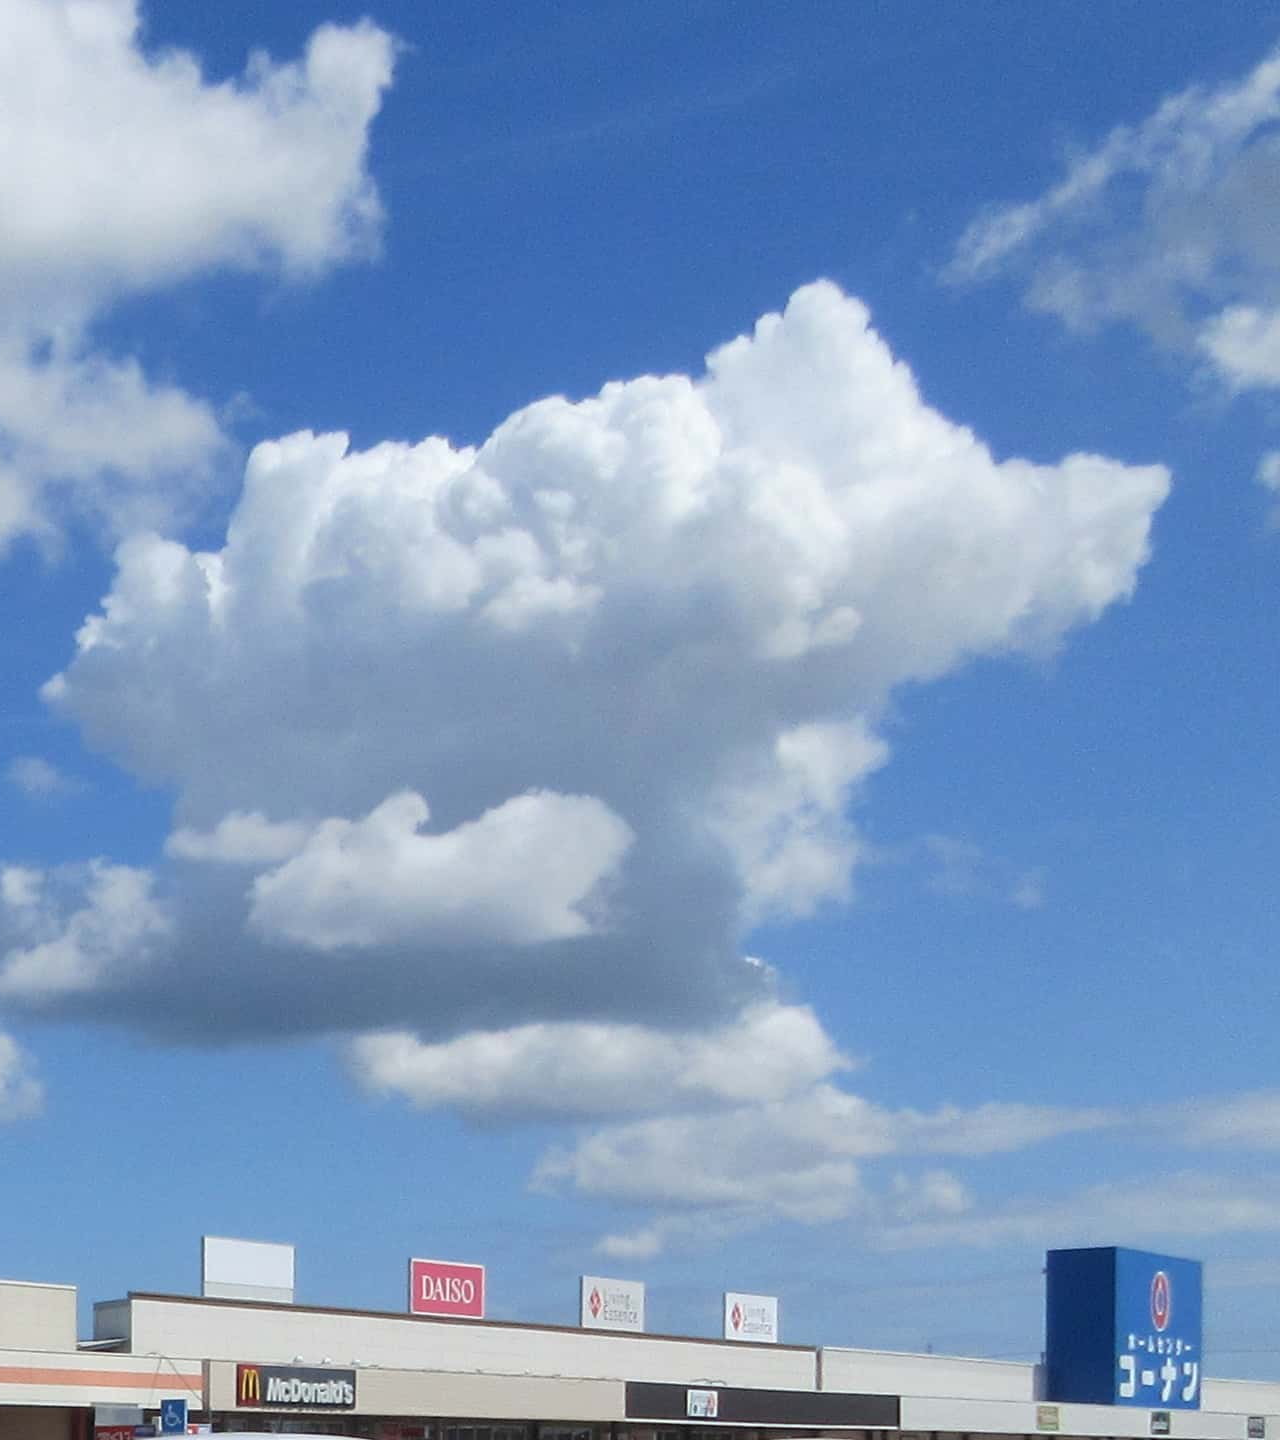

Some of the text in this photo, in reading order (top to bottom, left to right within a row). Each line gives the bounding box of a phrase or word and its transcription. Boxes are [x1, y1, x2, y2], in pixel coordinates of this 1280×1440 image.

[421, 1274, 475, 1305] DAISO
[1128, 1334, 1192, 1356] ホームセンター
[266, 1377, 354, 1404] McDonald's
[1119, 1354, 1198, 1402] コーナン
